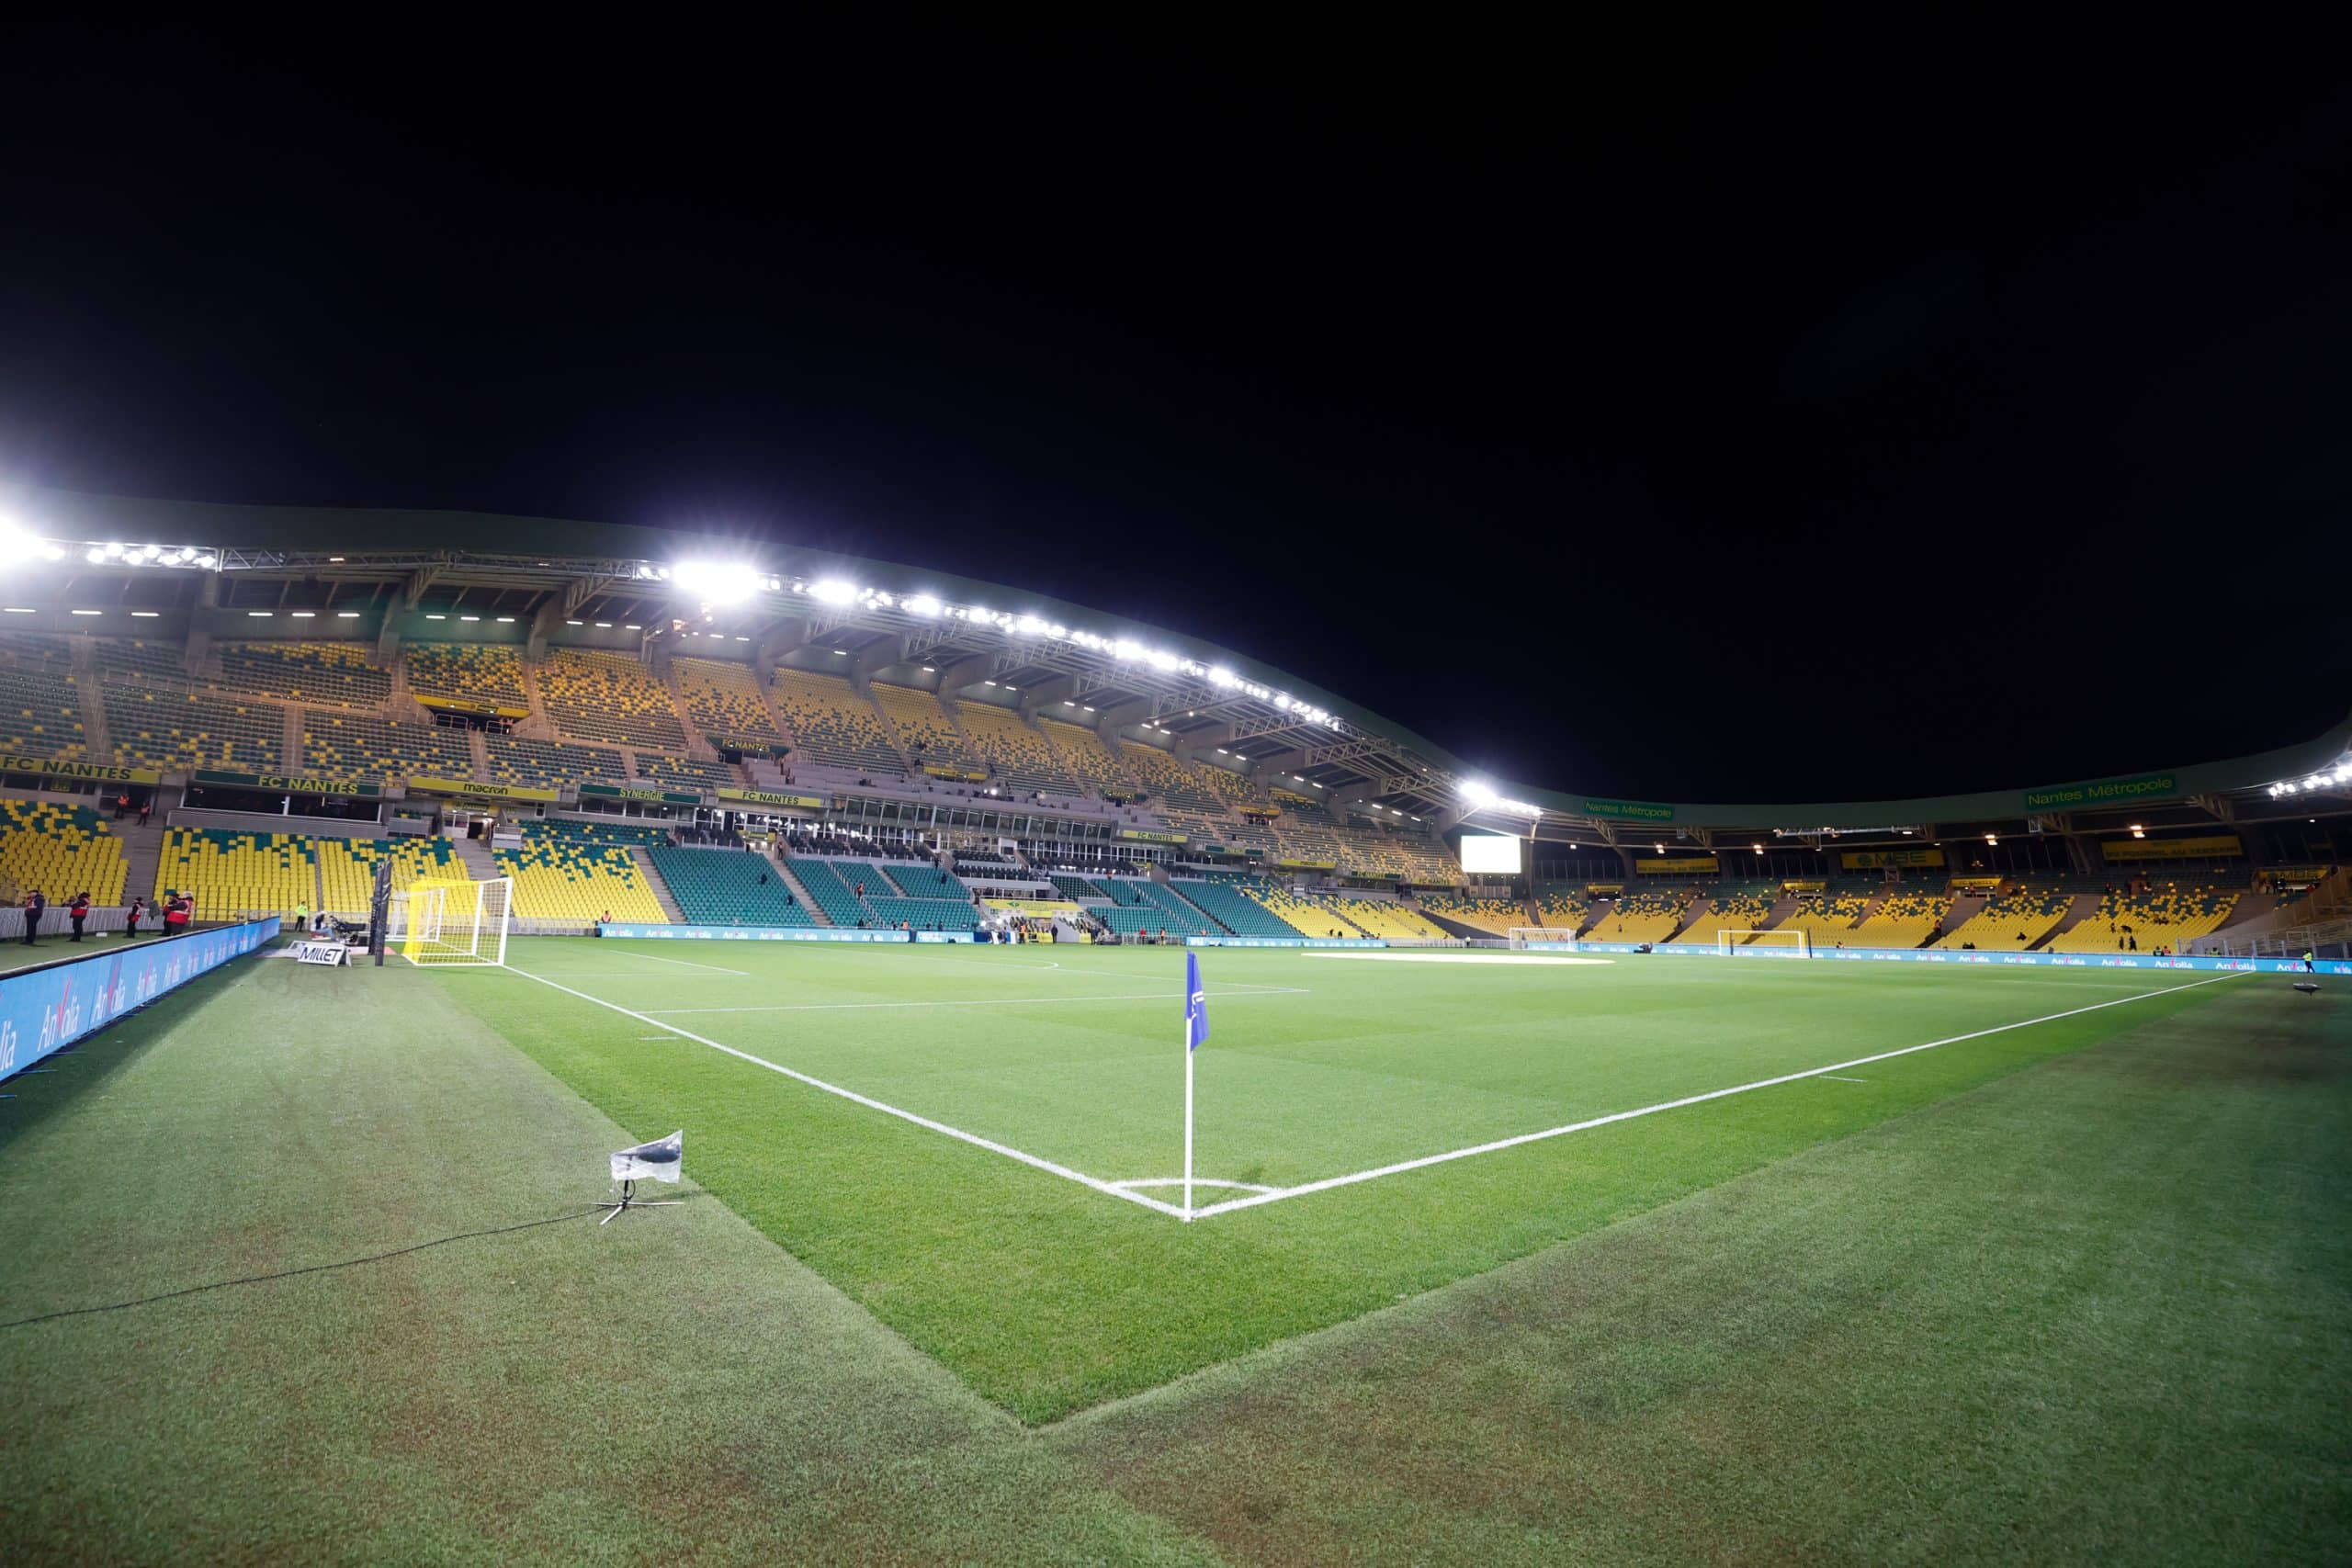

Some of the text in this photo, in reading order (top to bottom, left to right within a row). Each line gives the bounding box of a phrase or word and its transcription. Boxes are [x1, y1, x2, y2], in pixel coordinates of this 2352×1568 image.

[3, 756, 132, 781] FC NANTES
[258, 775, 358, 795] FC NANTES
[463, 783, 508, 795] macron
[2028, 777, 2173, 806] Nantes Métropole
[619, 787, 666, 802] SYNERGIE
[742, 791, 799, 806] FC NANTES
[1585, 801, 1672, 818] Nantes Métropole
[1148, 832, 1173, 841] NANTES
[1874, 850, 1928, 864] MBE
[300, 945, 343, 963] MILLET
